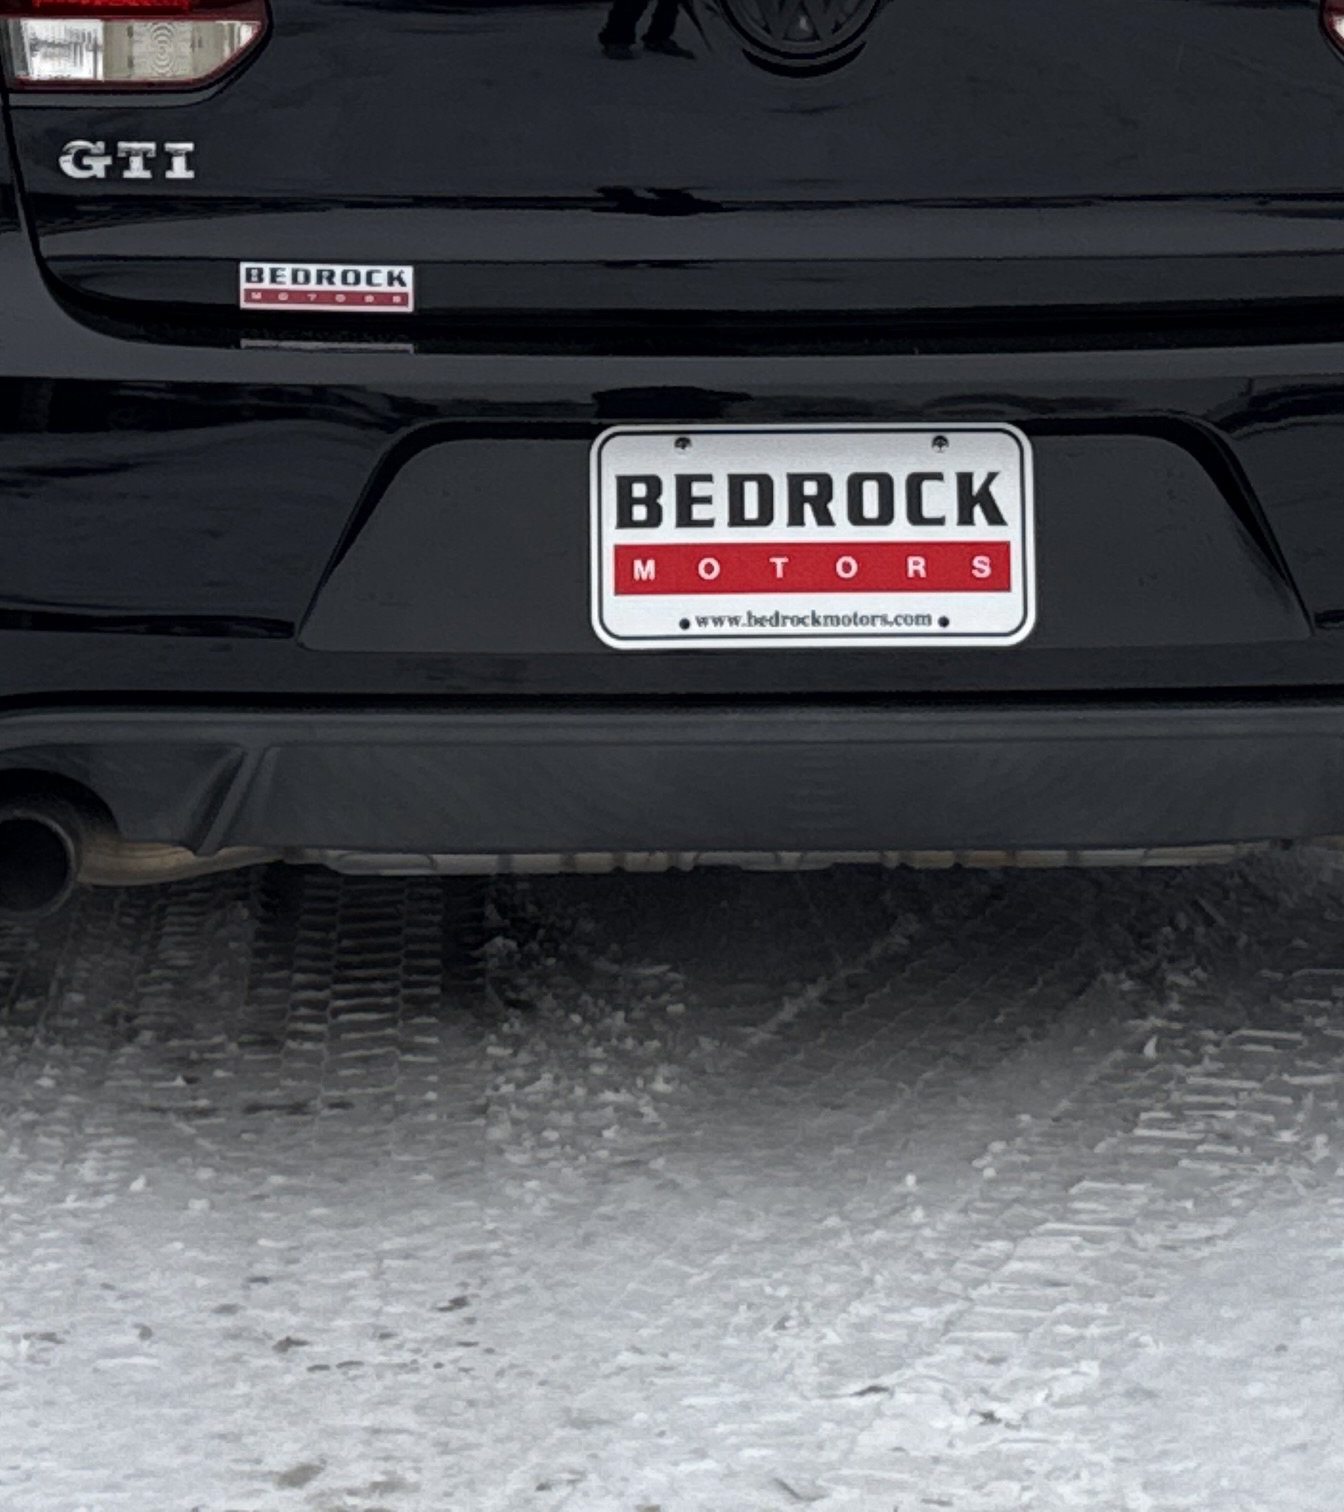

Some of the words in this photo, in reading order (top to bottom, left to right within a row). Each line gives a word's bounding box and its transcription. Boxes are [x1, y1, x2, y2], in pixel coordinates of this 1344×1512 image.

[58, 140, 195, 179] GTI
[245, 267, 407, 288] BEDROCK
[614, 471, 1009, 530] BEDROCK
[632, 555, 993, 582] MOTORS
[694, 609, 933, 629] www.bedrockmotors.com
